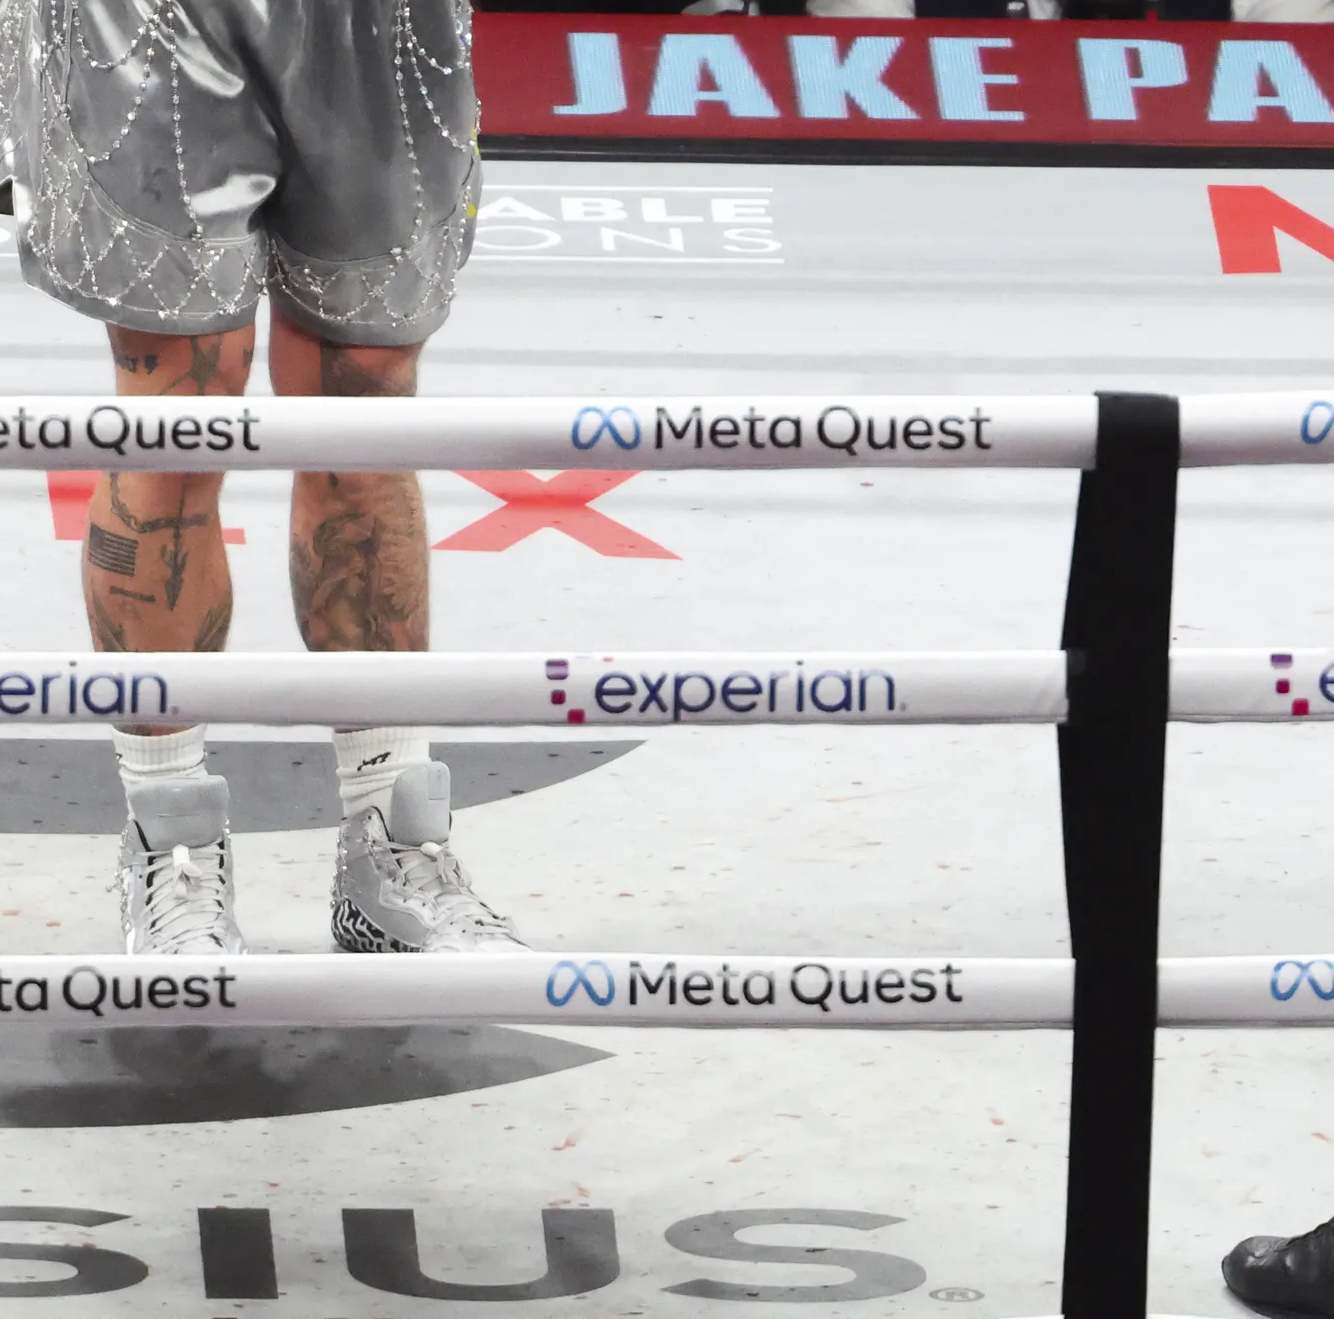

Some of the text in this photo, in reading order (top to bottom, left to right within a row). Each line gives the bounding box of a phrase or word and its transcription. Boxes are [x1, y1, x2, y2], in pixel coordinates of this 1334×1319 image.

[553, 32, 1025, 122] JAKE
[85, 406, 260, 456] Quest
[655, 406, 991, 457] Meta Quest
[594, 658, 894, 720] experian
[62, 967, 236, 1013] Quest
[629, 961, 963, 1012] Meta Quest
